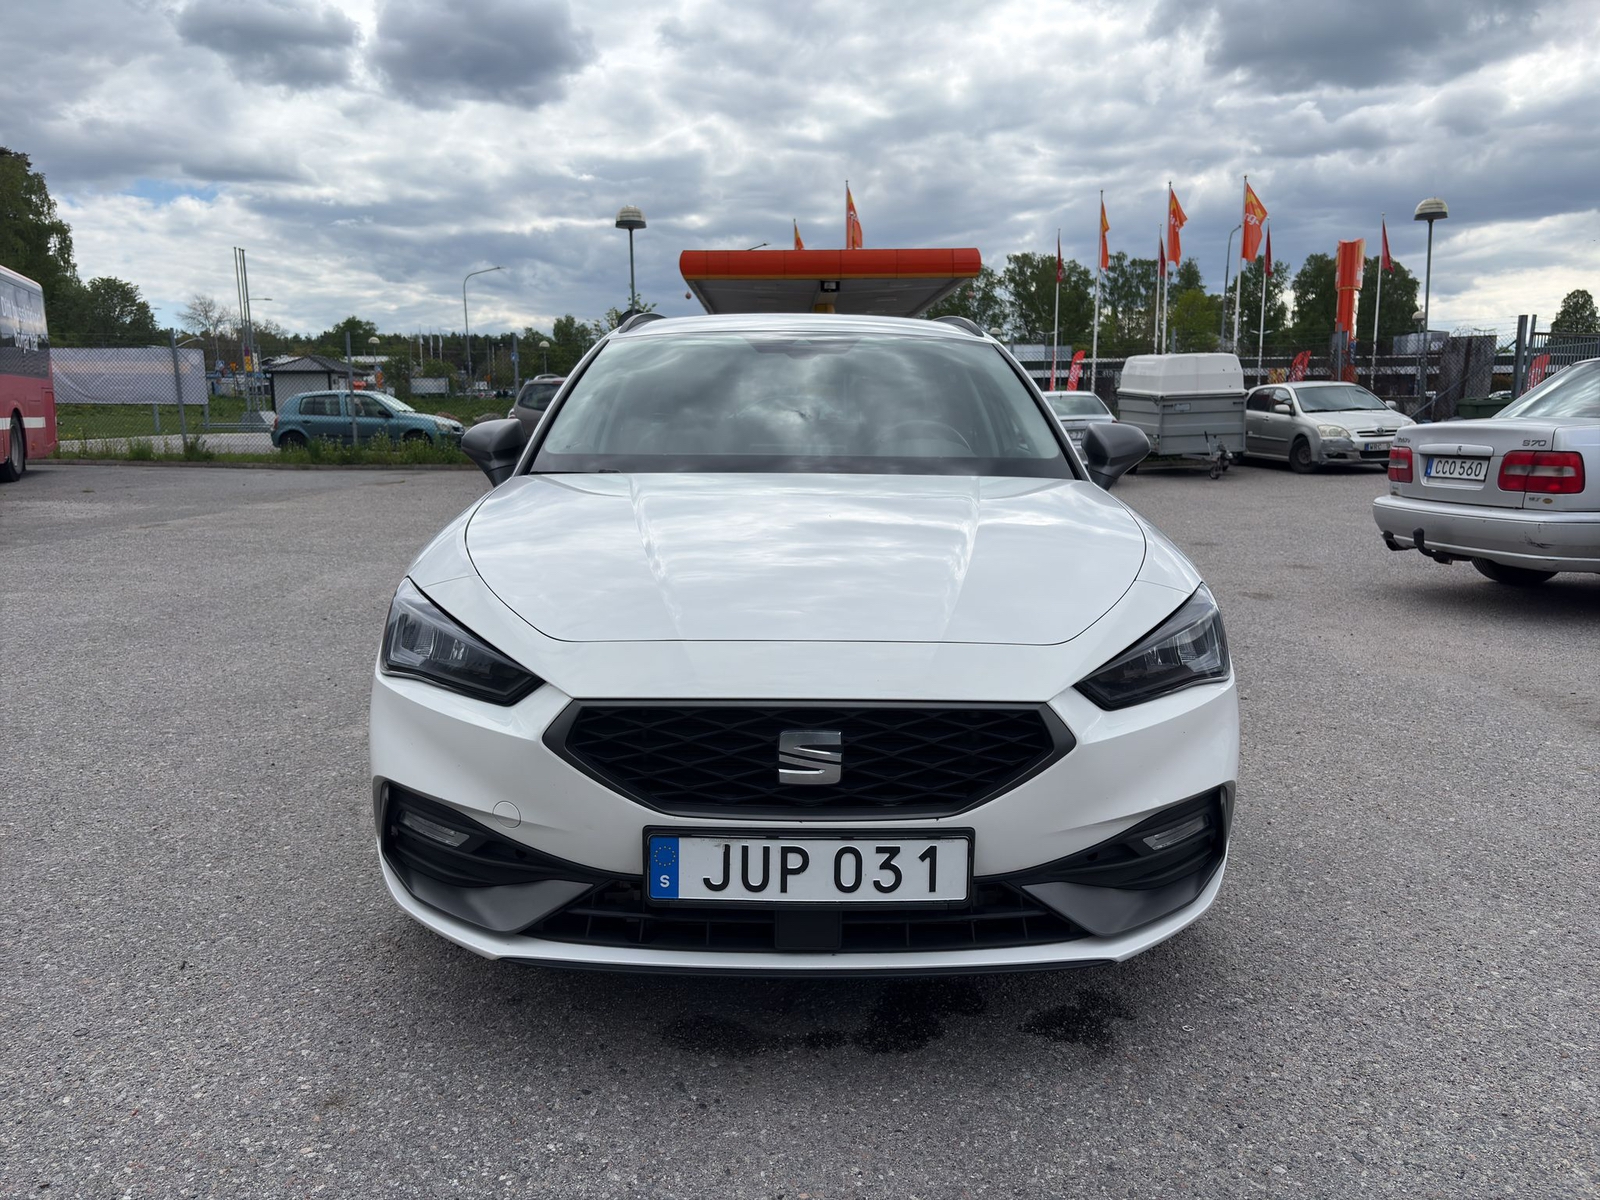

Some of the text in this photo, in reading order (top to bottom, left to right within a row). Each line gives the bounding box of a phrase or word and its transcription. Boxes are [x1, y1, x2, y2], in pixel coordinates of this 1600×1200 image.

[1522, 439, 1547, 447] S70
[1435, 460, 1482, 477] CCO 560
[703, 844, 938, 893] JUP 031
[660, 875, 670, 888] S
